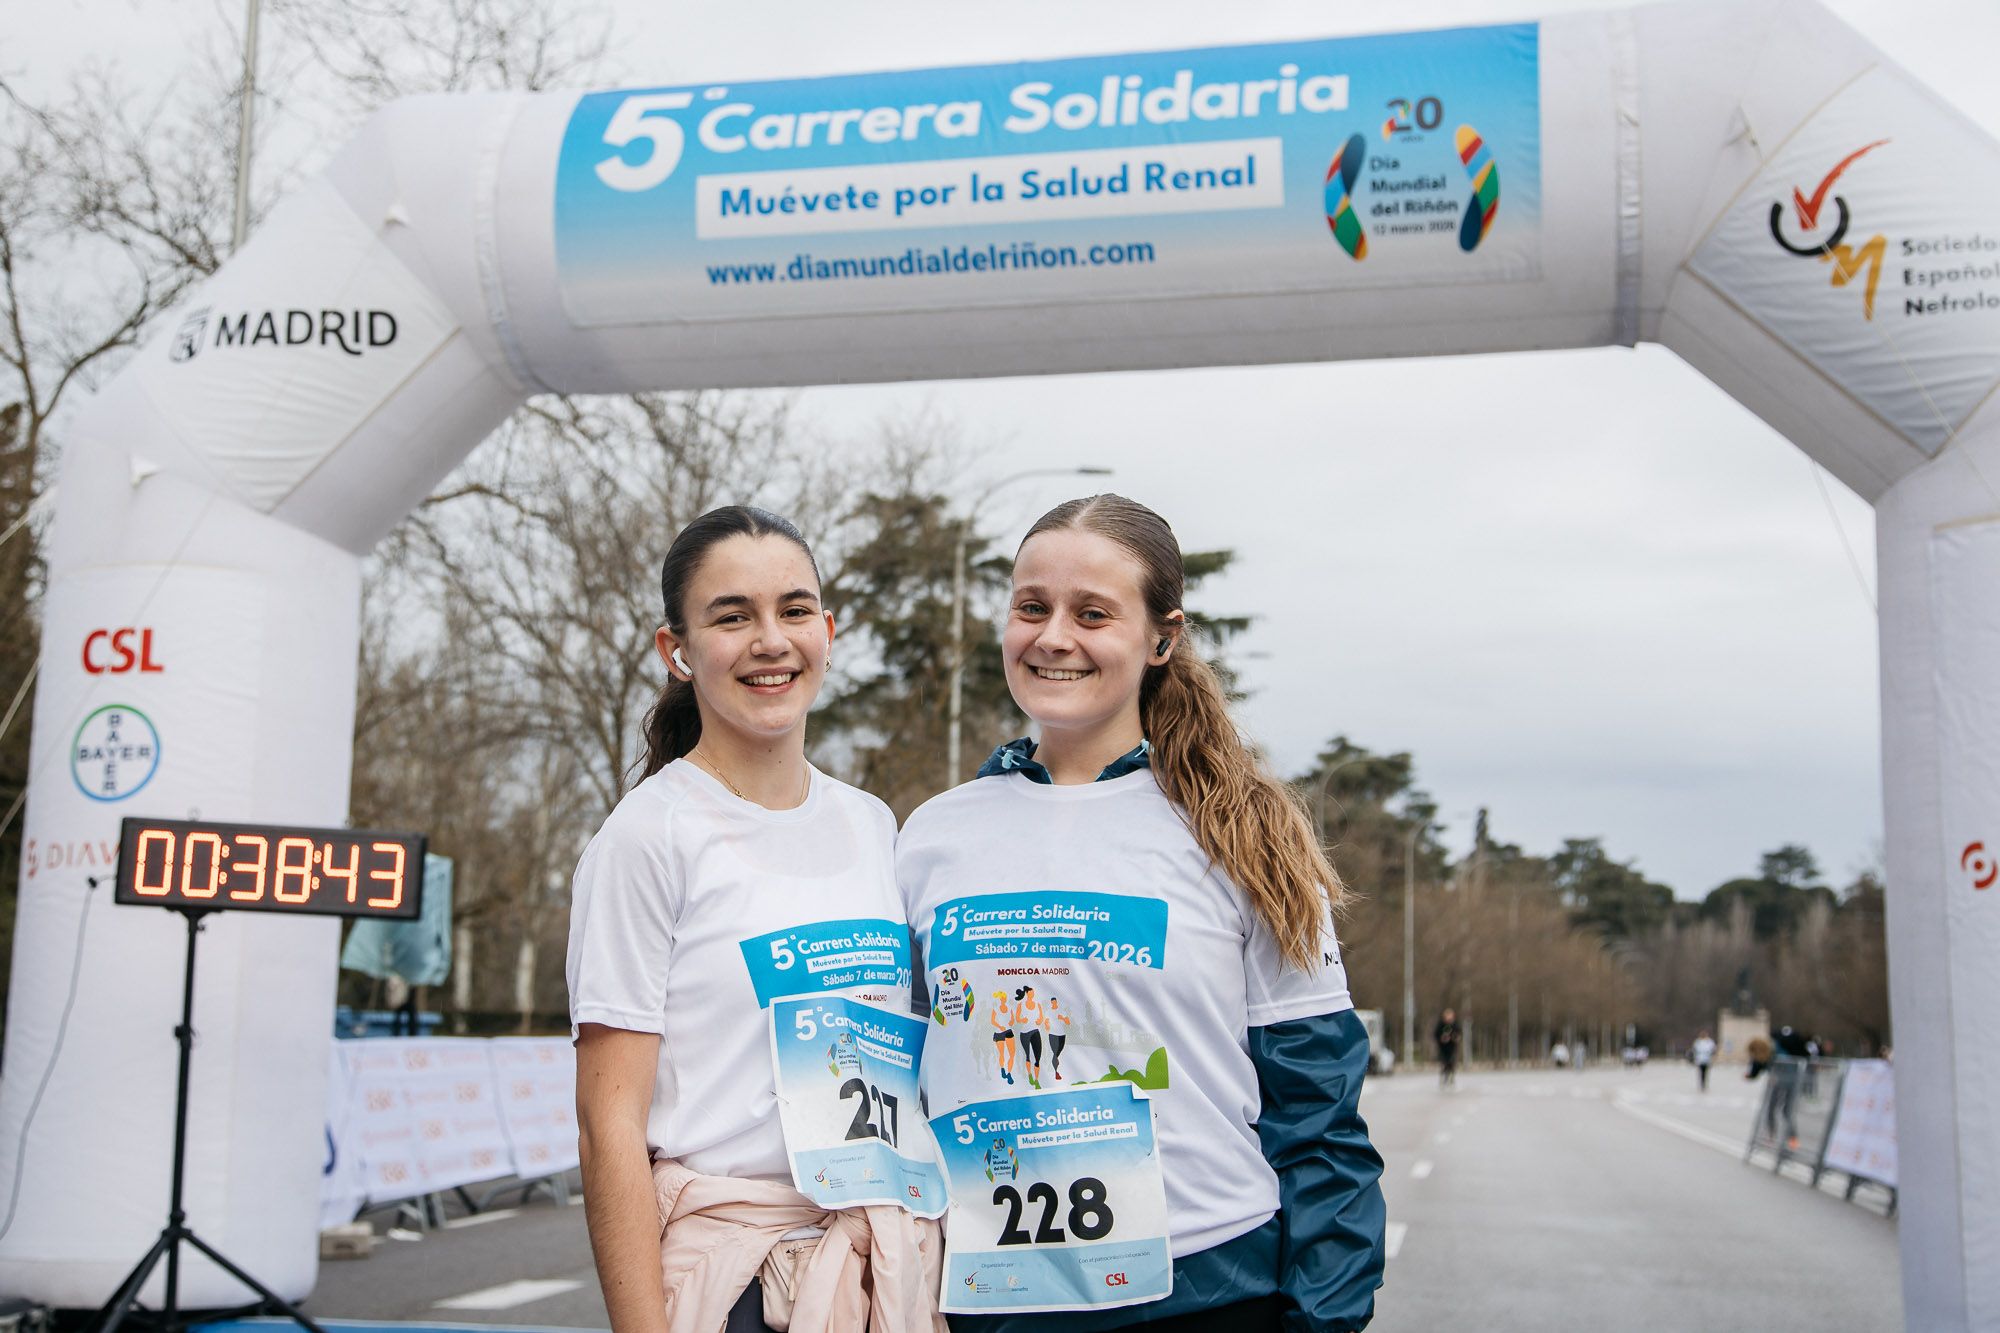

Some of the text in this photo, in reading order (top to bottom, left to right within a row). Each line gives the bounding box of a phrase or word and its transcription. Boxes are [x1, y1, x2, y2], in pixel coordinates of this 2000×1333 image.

[698, 100, 982, 154] Carrera
[1003, 63, 1350, 134] Solidaria
[1383, 97, 1443, 132] 20
[720, 155, 1256, 218] Muévete por la Salud Renal
[1369, 174, 1447, 193] Mundial
[1371, 202, 1400, 217] del
[706, 240, 1156, 285] www.diamundialdelriñon.com
[215, 309, 398, 356] MADRID
[82, 627, 165, 676] CSL
[78, 746, 151, 761] BAYER
[134, 829, 406, 909] 00:38:43
[962, 908, 1027, 924] Carrera
[1032, 903, 1111, 922] Solidaria
[969, 926, 1082, 936] Muévete por la Salud Renal
[798, 937, 853, 954] Carrera
[852, 932, 901, 948] Solidaria
[975, 939, 1153, 968] Sábado 7 de marzo 2026
[812, 957, 842, 968] Muévete
[844, 957, 854, 965] por
[862, 952, 878, 961] Salud
[822, 971, 855, 986] Sábado
[856, 970, 862, 981] 7
[864, 969, 877, 980] de
[877, 971, 896, 981] marzo
[942, 967, 959, 983] 20
[997, 967, 1070, 976] MONCLOA MADRID
[822, 1012, 862, 1034] Carrera
[864, 1021, 904, 1048] Solidaria
[977, 1117, 1032, 1133] Carrera
[1035, 1105, 1114, 1128] Solidaria
[1022, 1134, 1054, 1145] Muévete
[1056, 1134, 1071, 1143] por
[1083, 1128, 1108, 1138] Salud
[1109, 1125, 1134, 1135] Renal
[992, 1177, 1115, 1247] 228
[1105, 1272, 1129, 1287] CSL
